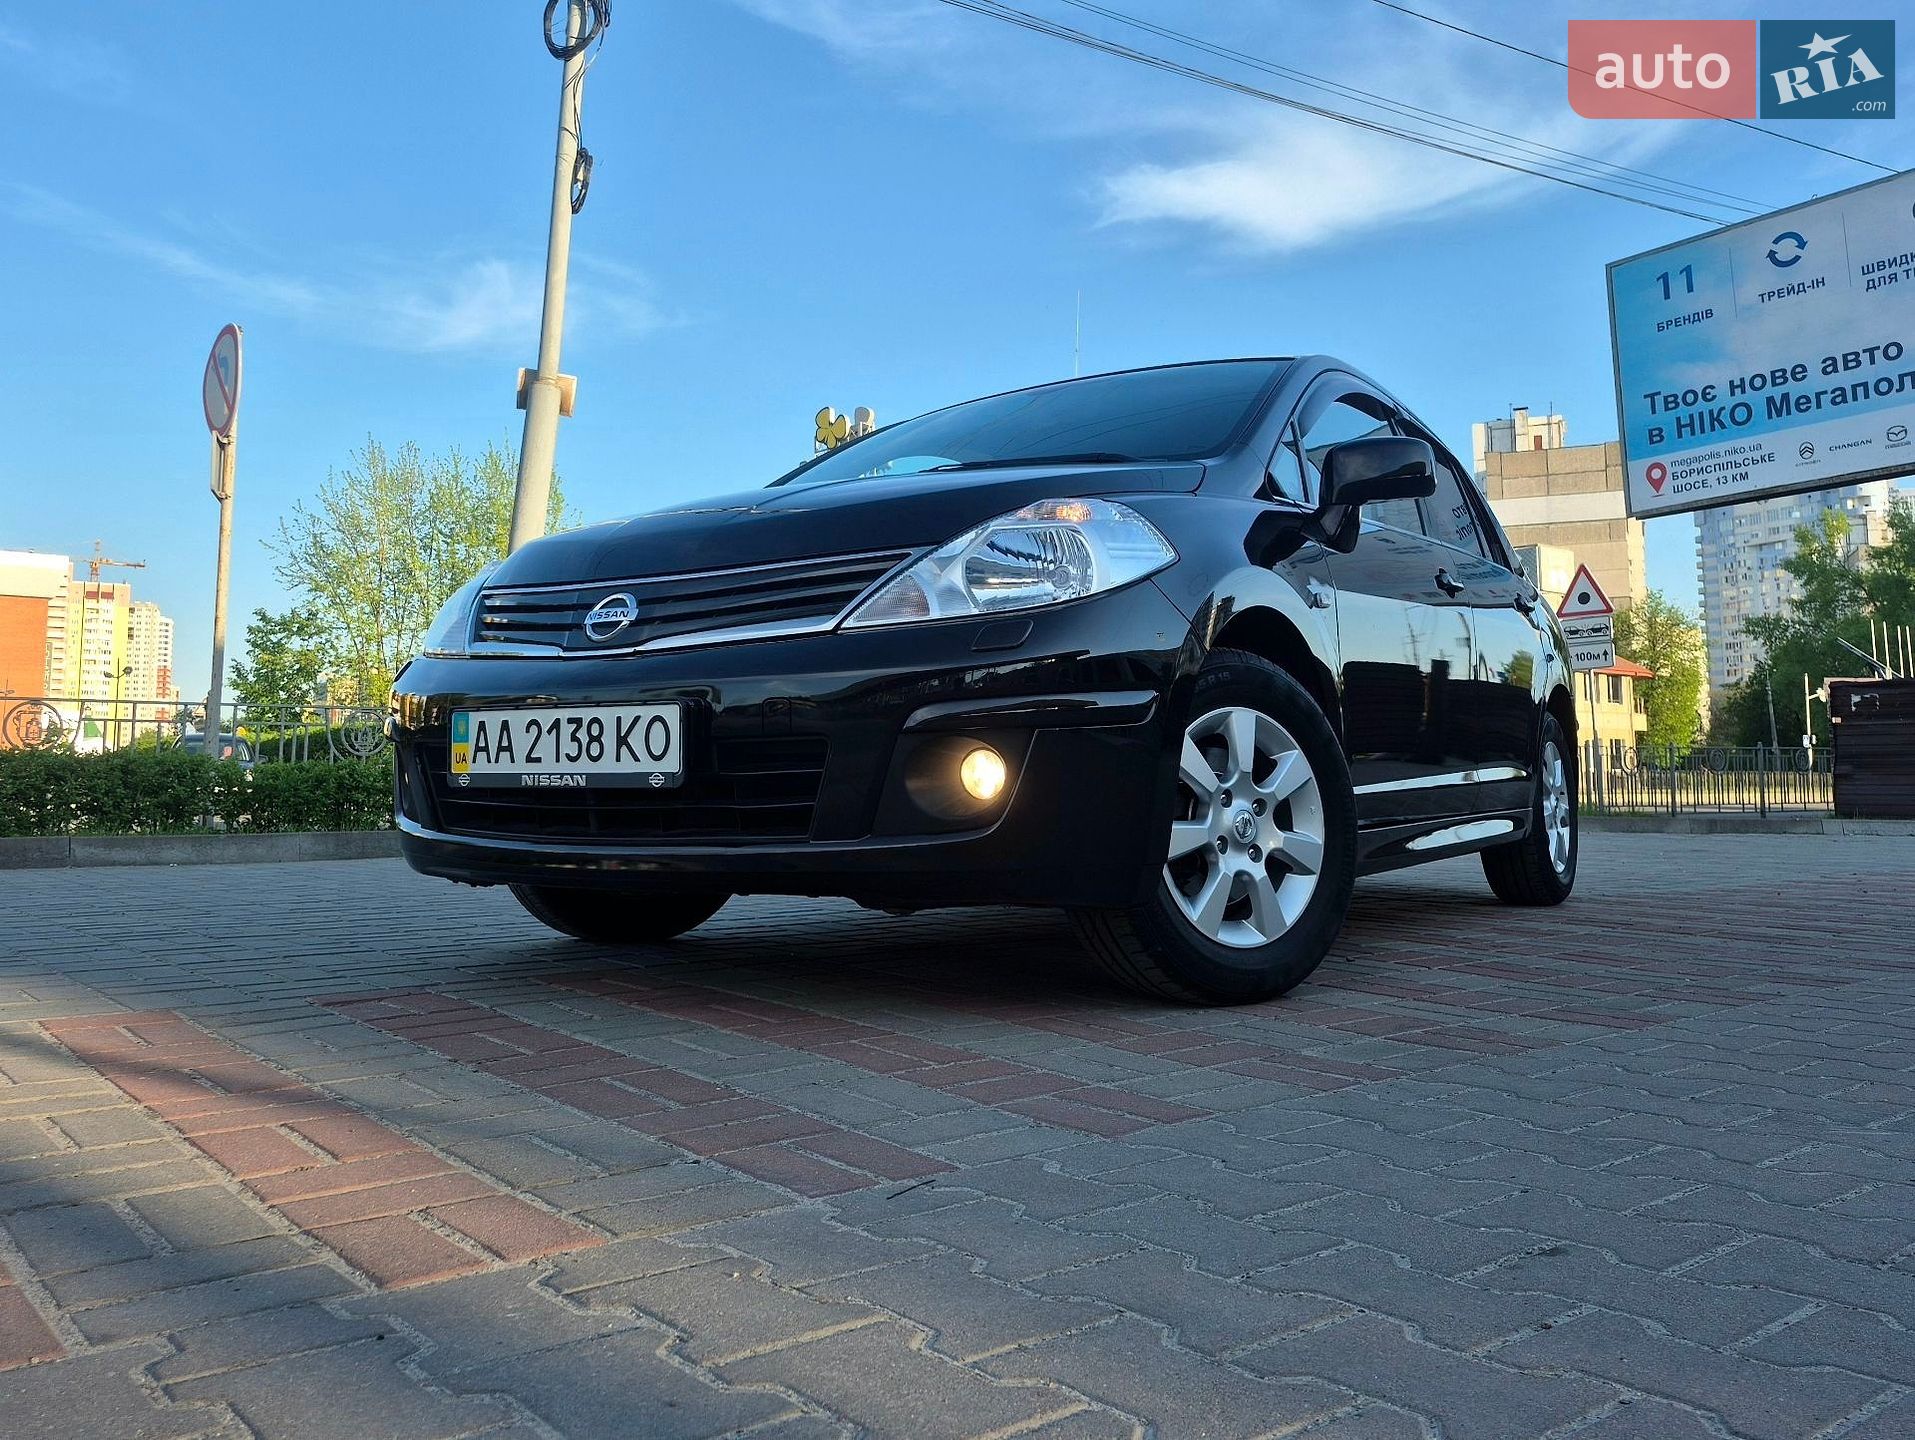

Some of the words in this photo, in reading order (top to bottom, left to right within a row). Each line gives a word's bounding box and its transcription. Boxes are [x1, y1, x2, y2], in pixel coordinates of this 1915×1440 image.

[1656, 264, 1695, 300] 11
[1758, 276, 1826, 304] ТРЕЙД-ІН
[1866, 272, 1898, 293] ДЛЯ
[1656, 308, 1714, 333] БРЕНДІВ
[1643, 384, 1718, 415] Твоє
[1728, 363, 1809, 397] нове
[1821, 341, 1904, 376] авто
[1648, 427, 1665, 446] в
[1675, 401, 1753, 439] НІКО
[1670, 442, 1763, 468] megapolis.niko.ua
[1829, 439, 1872, 452] CHANGAN
[1671, 452, 1776, 481] БОРИСПІЛЬСЬКЕ
[1672, 478, 1713, 494] ШОСЕ,
[1716, 476, 1729, 486] 13
[1731, 471, 1749, 483] КМ
[590, 610, 629, 620] NISSAN
[472, 720, 515, 764] AA
[525, 716, 604, 764] 2138
[615, 714, 671, 763] KO
[455, 753, 468, 764] UA
[521, 774, 587, 787] NISSAN
